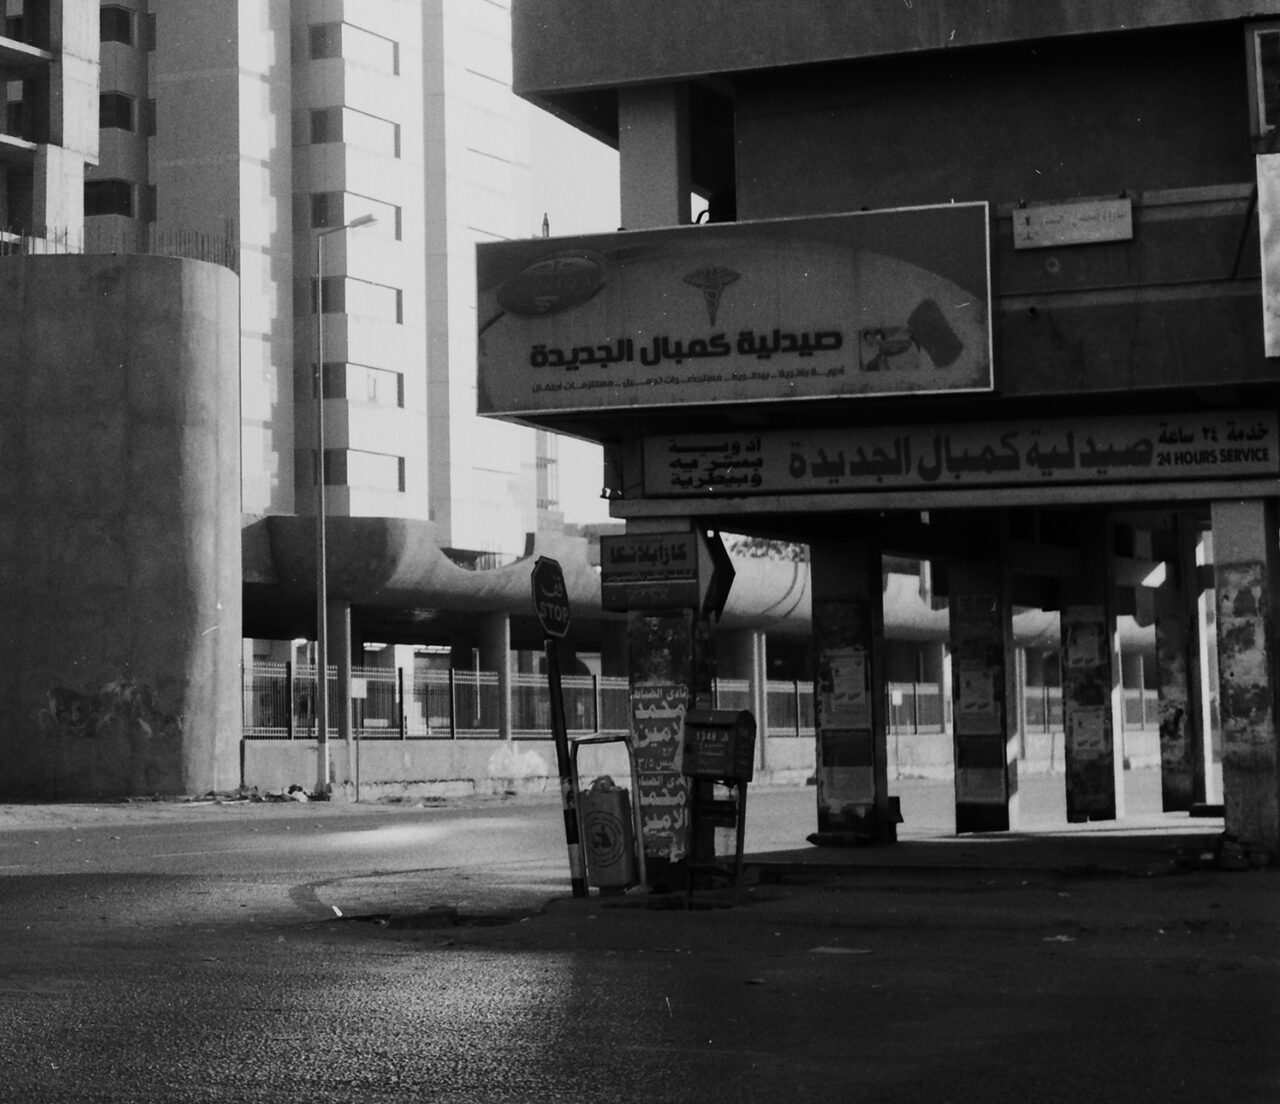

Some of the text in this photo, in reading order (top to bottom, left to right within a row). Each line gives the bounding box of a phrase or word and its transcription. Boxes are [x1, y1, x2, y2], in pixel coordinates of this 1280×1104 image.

[529, 329, 843, 371] صيدلية كمبال الجديدة
[1158, 422, 1195, 444] ساعة
[1225, 420, 1269, 441] خدمة
[789, 428, 1154, 485] صيدلية كمبال الجديدة
[1157, 447, 1269, 466] 24 HOURS SERVICE
[540, 575, 564, 597] قف
[539, 601, 569, 623] STOP
[635, 700, 686, 718] محمد
